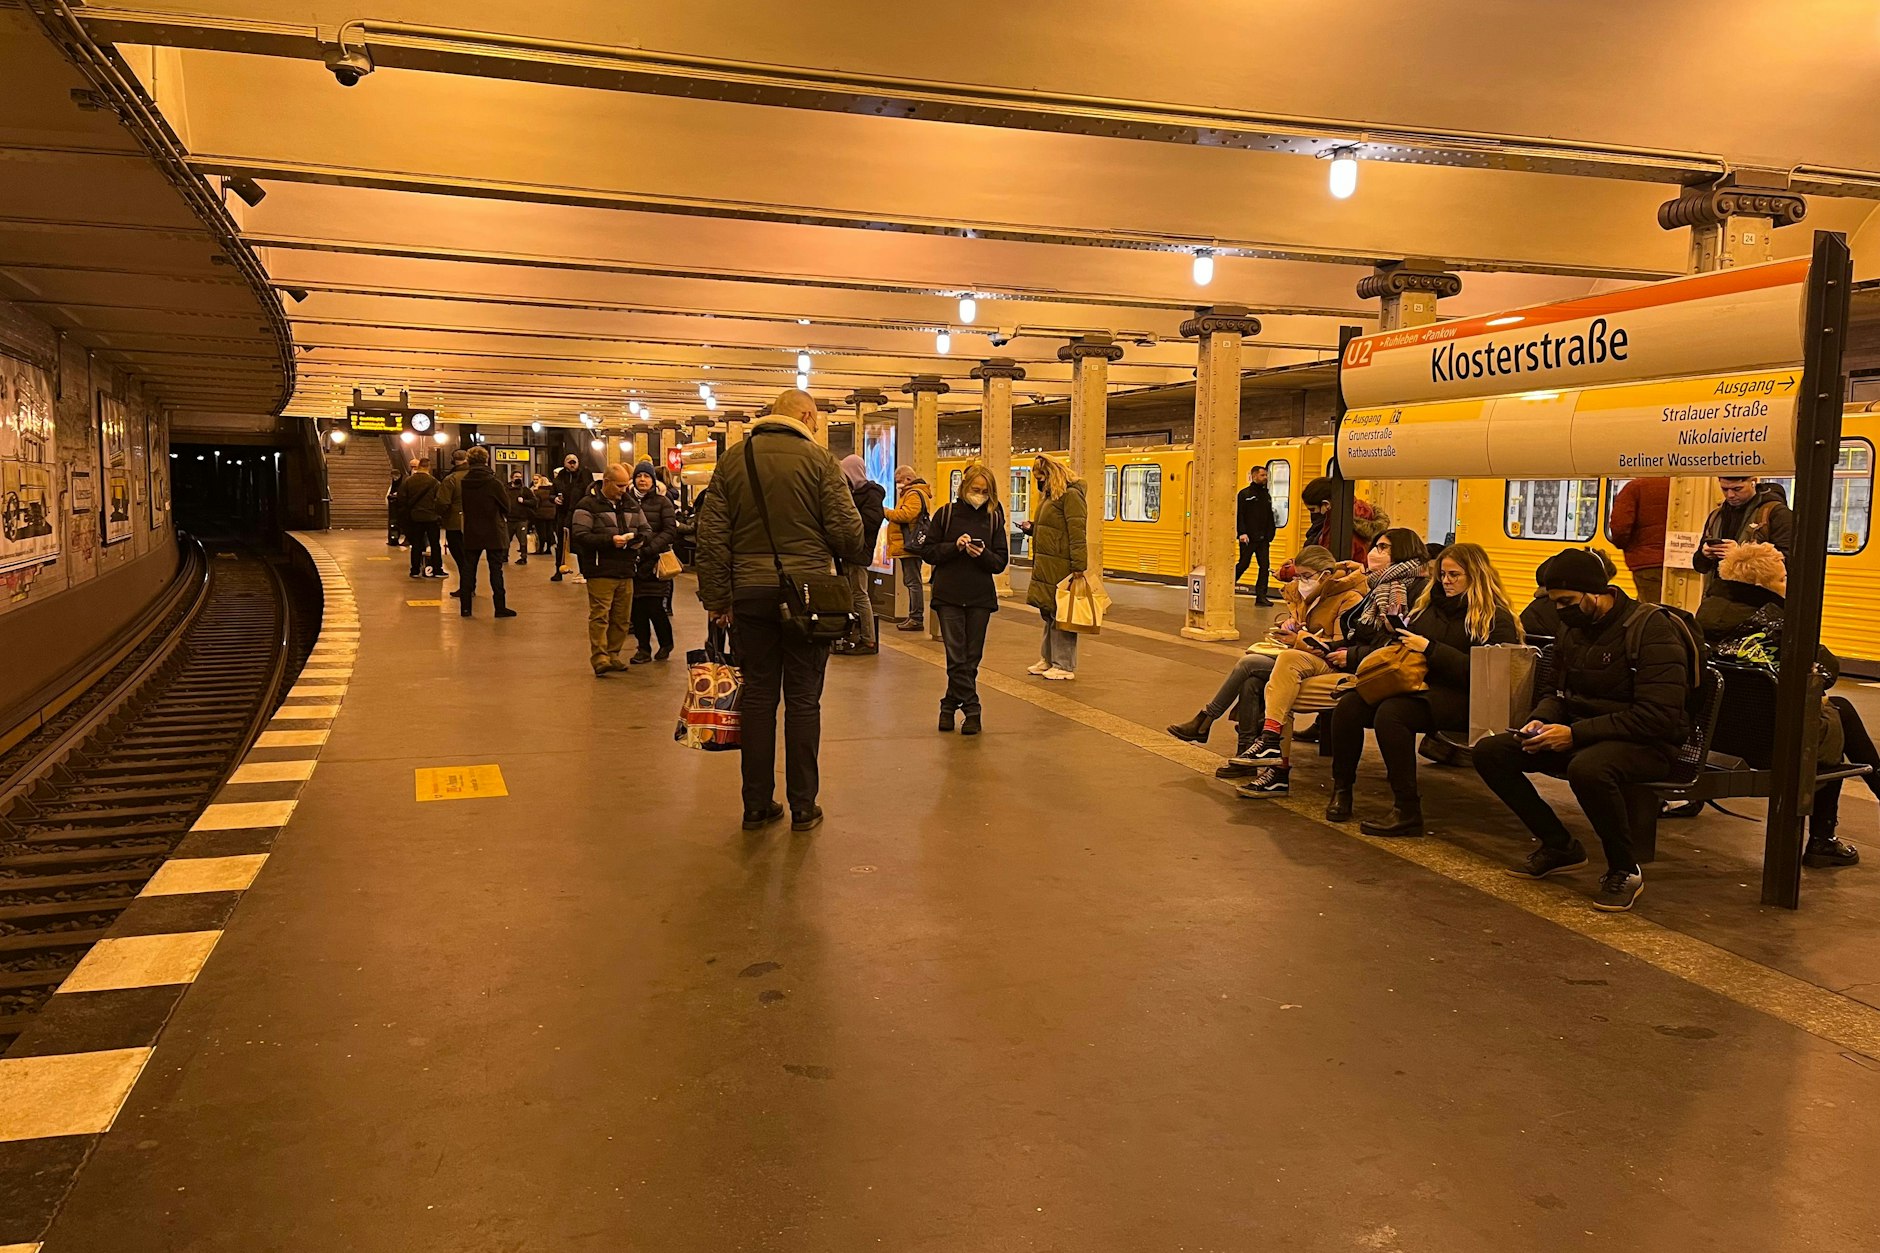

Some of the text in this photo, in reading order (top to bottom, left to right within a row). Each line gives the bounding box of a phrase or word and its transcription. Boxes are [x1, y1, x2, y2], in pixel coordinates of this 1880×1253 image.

[1384, 327, 1458, 347] Ruhleben Pankow
[1346, 340, 1373, 366] U2
[1431, 317, 1628, 382] Klosterstraße
[1713, 379, 1776, 397] Ausgang
[1352, 414, 1382, 426] Ausgang
[1661, 400, 1768, 422] Stralauer Straße
[1348, 428, 1393, 441] Grunerstraße
[1678, 425, 1769, 445] Nikolaiviertel
[1347, 445, 1396, 458] Rathausstraße
[1619, 452, 1664, 467] Berliner
